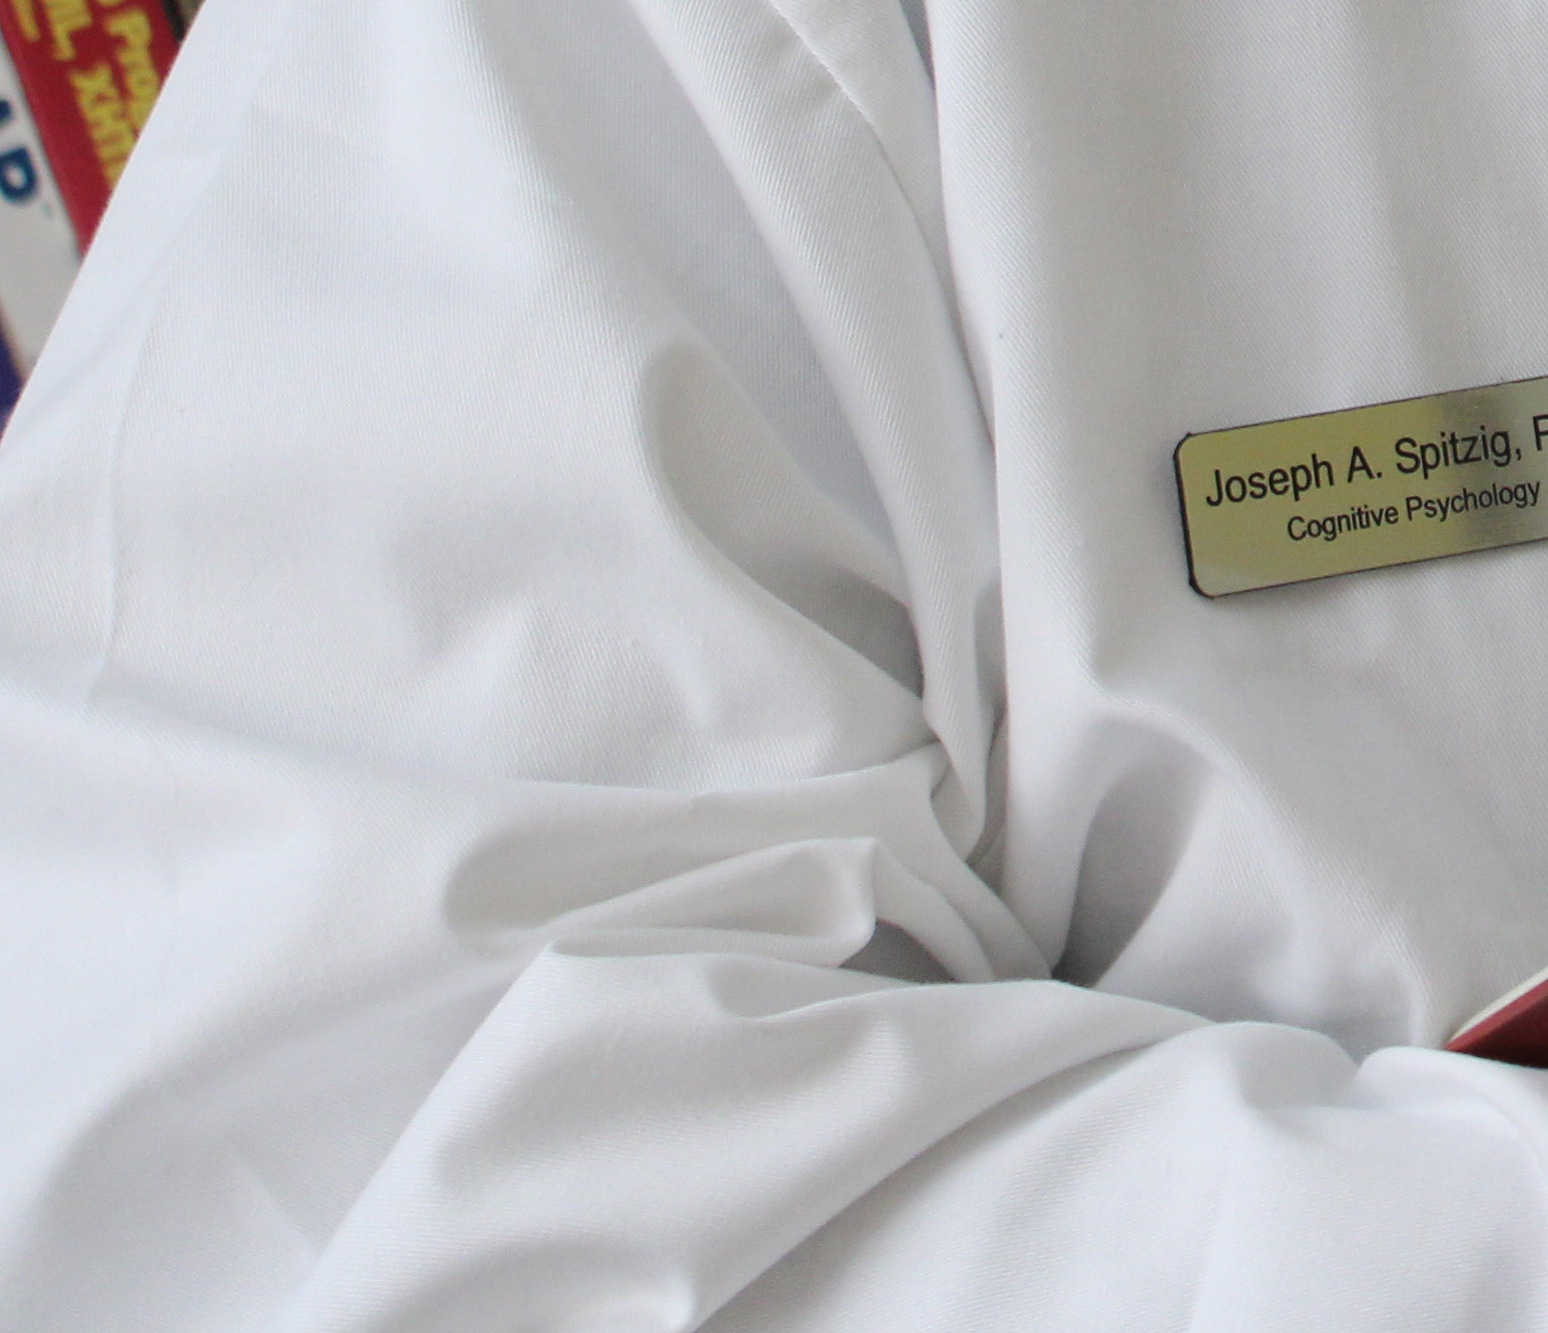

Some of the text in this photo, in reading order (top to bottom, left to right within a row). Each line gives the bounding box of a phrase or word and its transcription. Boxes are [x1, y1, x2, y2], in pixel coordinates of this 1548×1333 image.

[1205, 453, 1335, 508] Joseph
[1346, 445, 1383, 484] A.
[1394, 424, 1523, 481] Spitzig,
[1287, 479, 1541, 543] Cognitive Psychology
